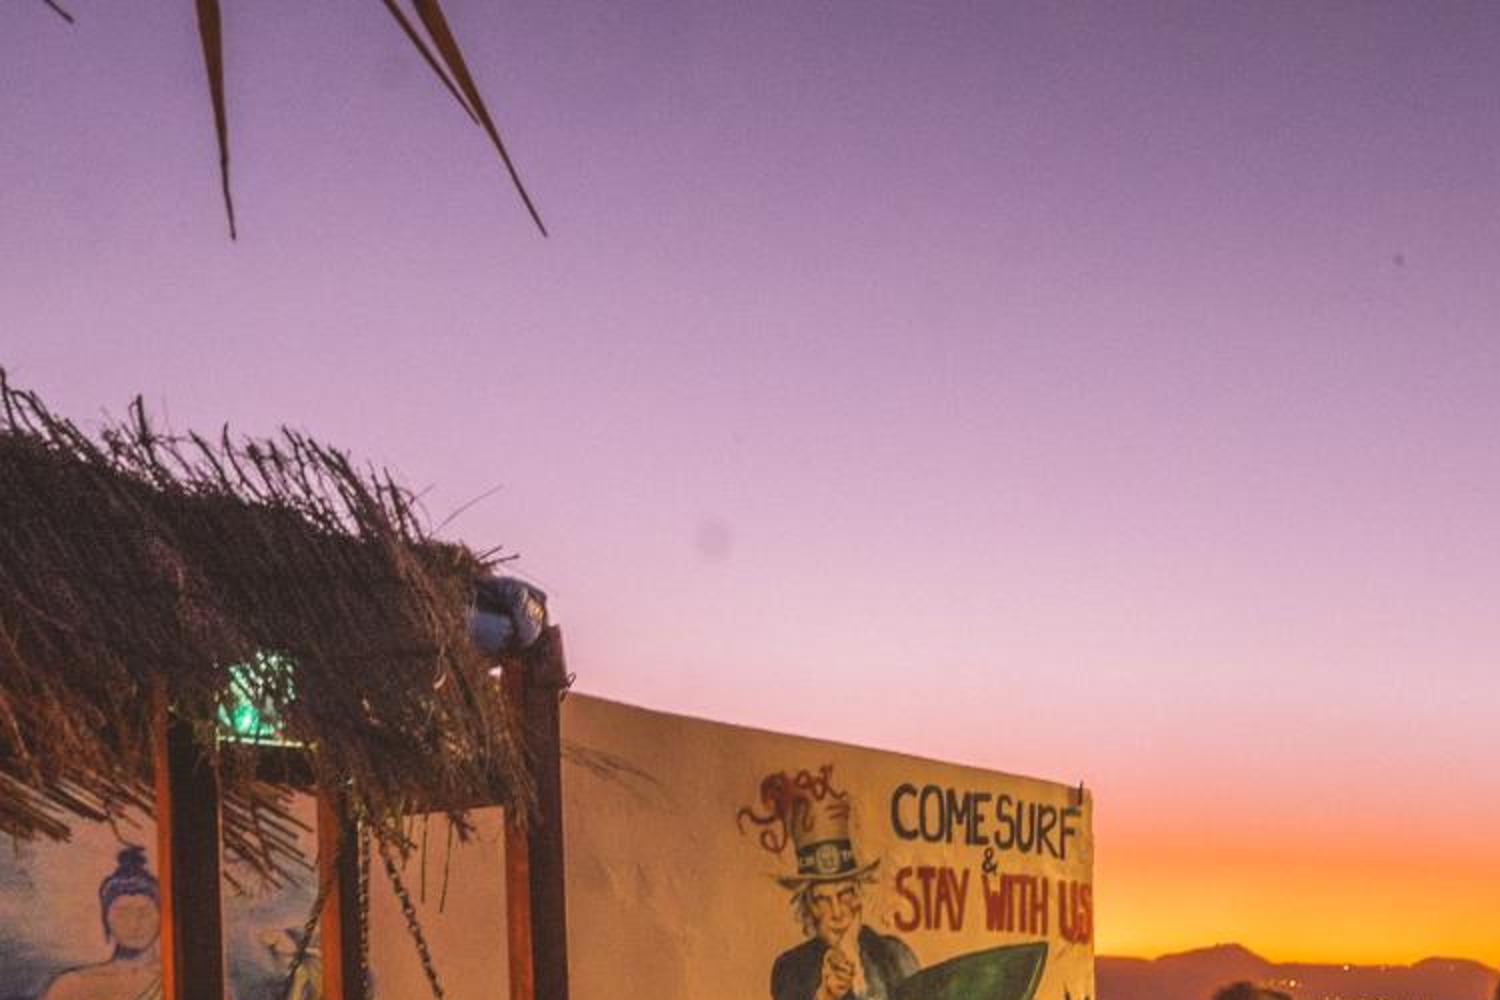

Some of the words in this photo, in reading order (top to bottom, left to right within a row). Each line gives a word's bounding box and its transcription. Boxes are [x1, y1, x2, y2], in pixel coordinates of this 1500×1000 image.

[891, 783, 992, 845] COME
[994, 794, 1081, 860] SURF
[982, 847, 997, 875] &
[894, 865, 970, 933] STAY
[982, 873, 1048, 936] WITH
[1057, 880, 1091, 944] US
